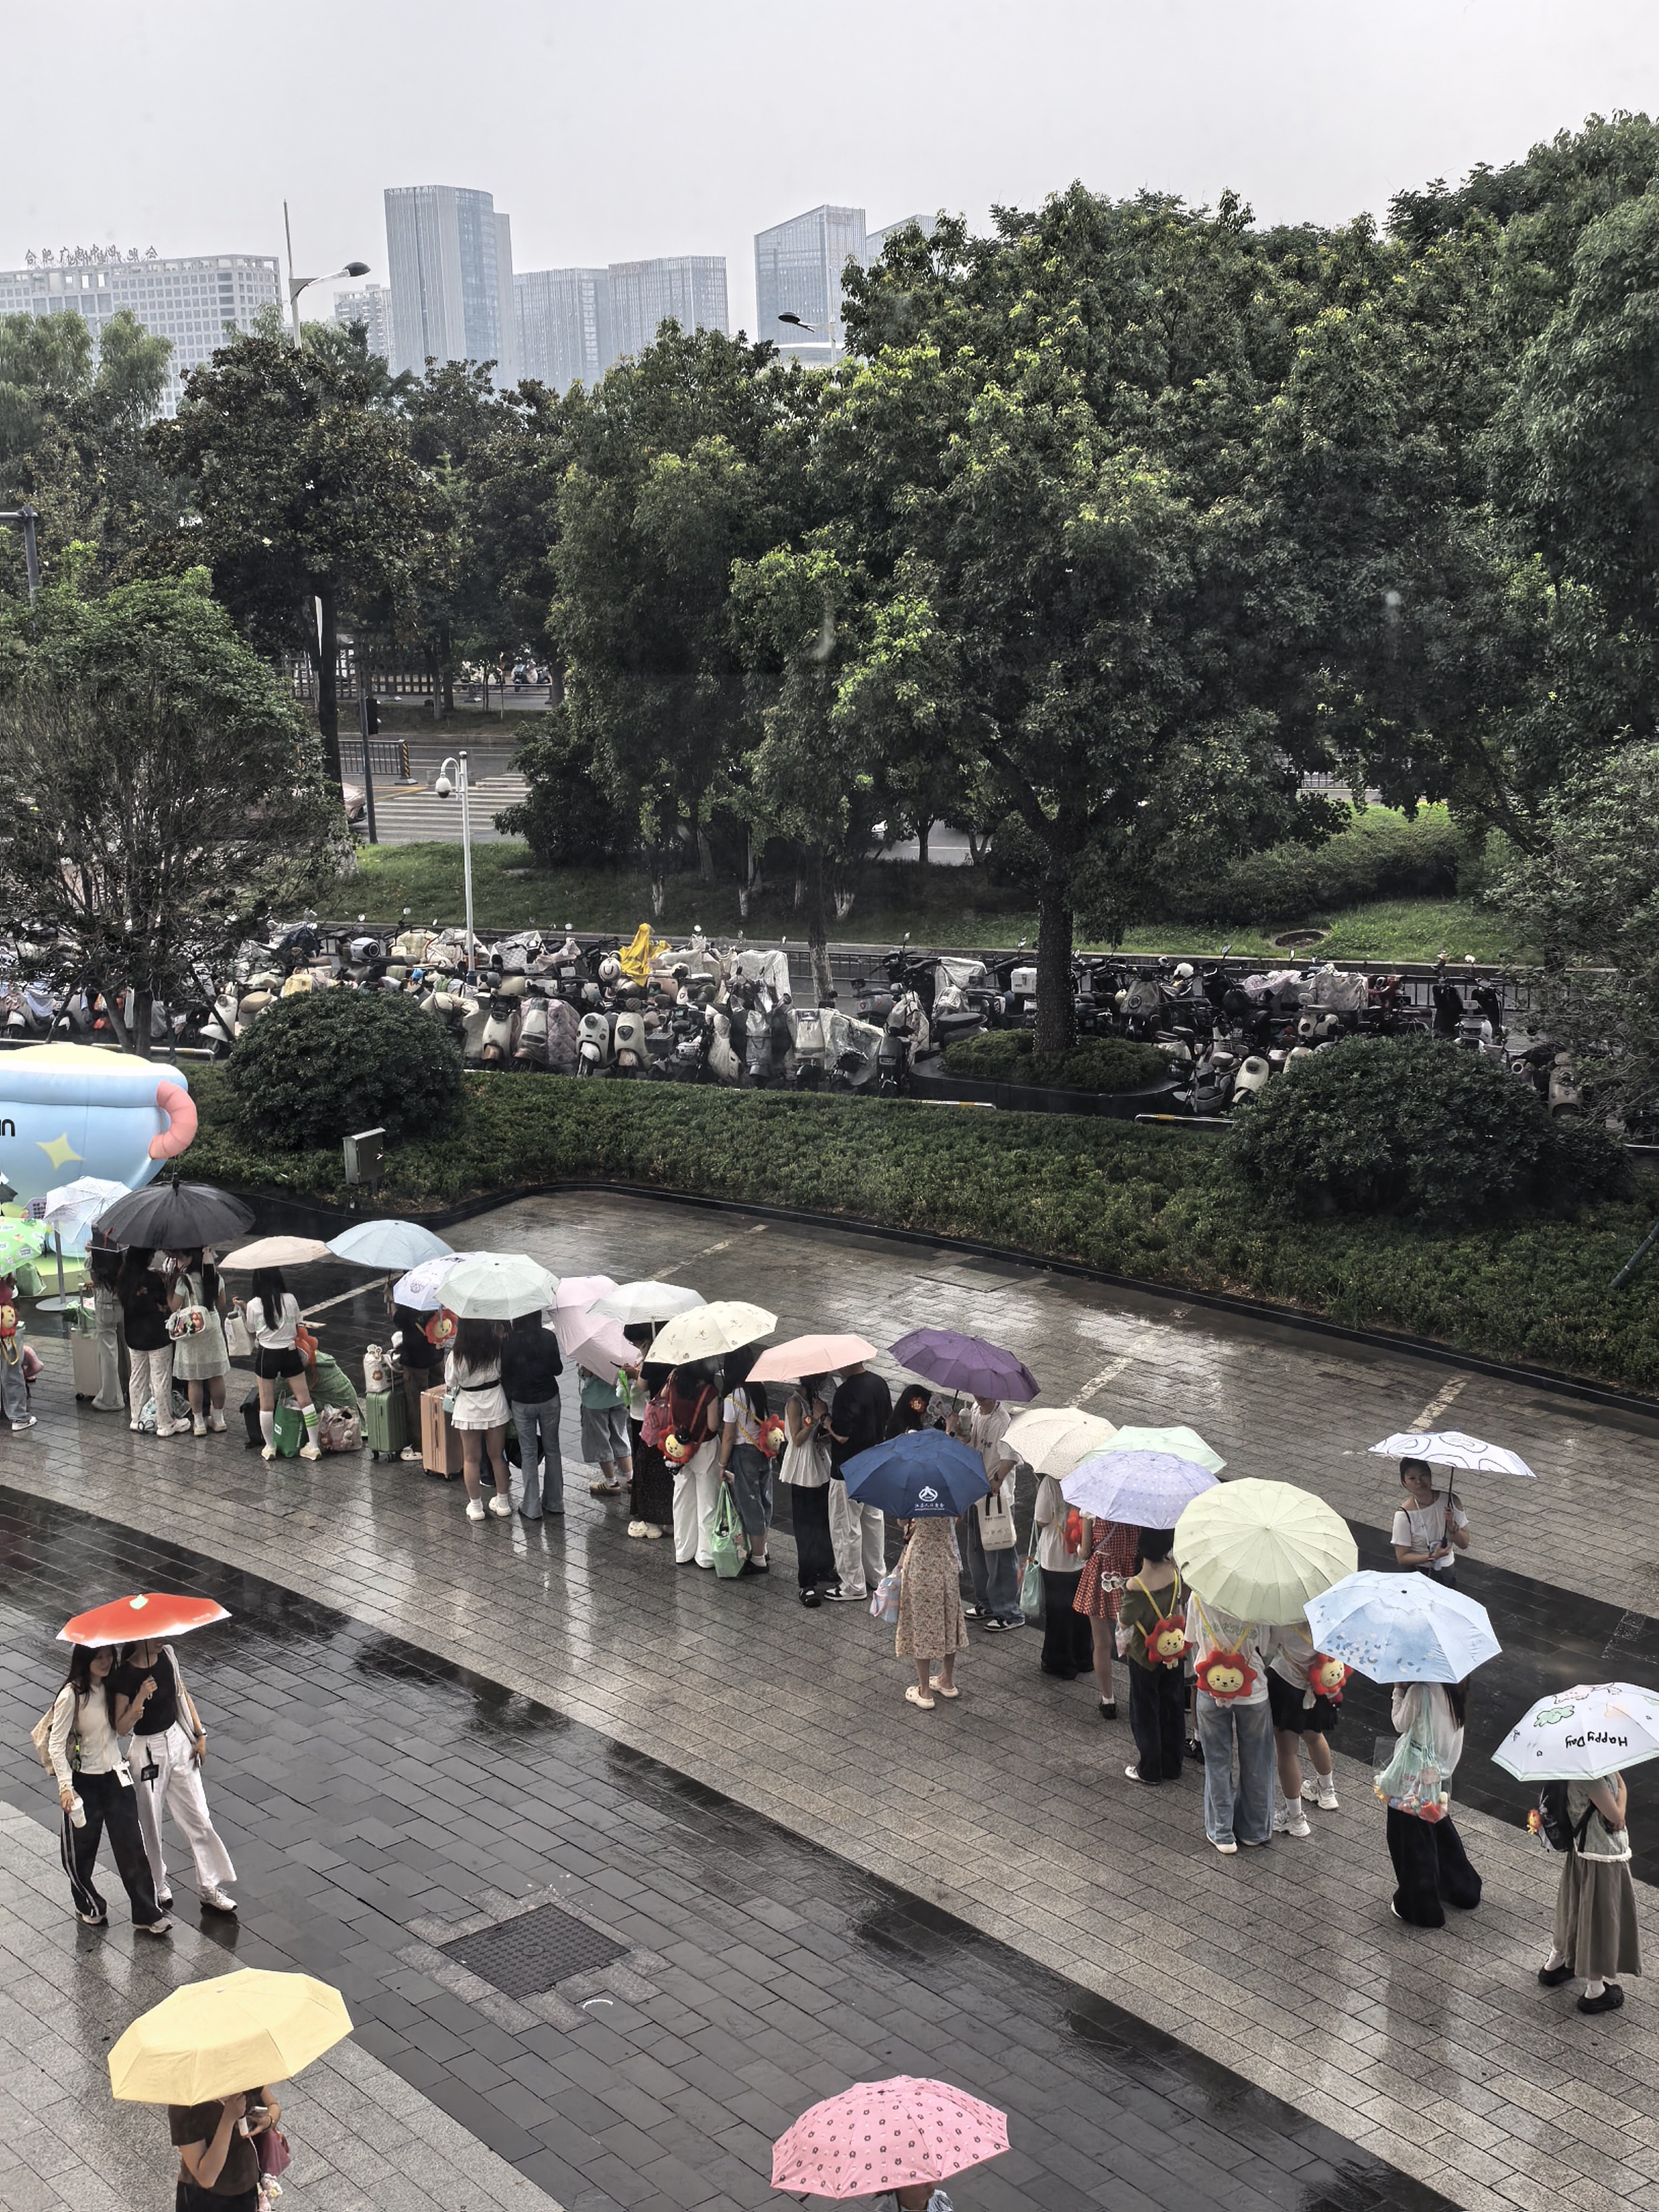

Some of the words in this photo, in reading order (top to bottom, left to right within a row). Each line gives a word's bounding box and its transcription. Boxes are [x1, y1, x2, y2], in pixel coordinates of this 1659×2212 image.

[0, 1118, 16, 1137] n
[1565, 1735, 1586, 1749] Day
[1587, 1731, 1628, 1747] Happy
